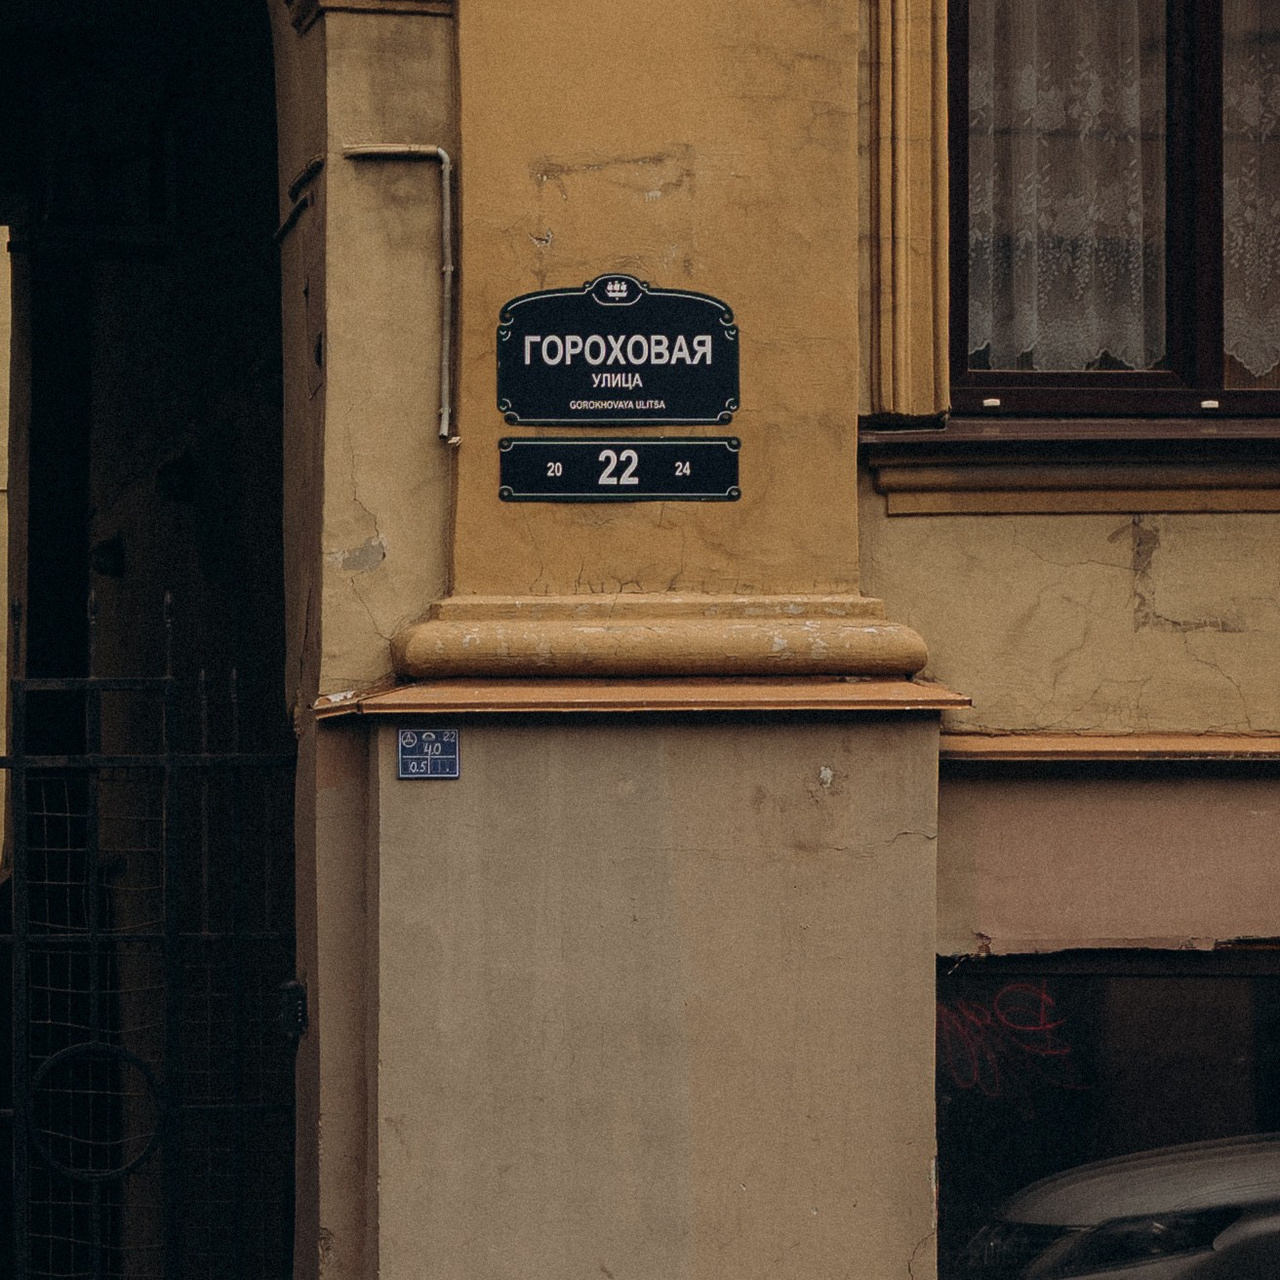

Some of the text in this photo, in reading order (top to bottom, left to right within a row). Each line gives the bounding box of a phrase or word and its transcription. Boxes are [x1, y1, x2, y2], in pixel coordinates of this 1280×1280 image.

[524, 334, 712, 366] ГОРОХОВАЯ
[592, 373, 643, 390] УЛИЦА
[569, 400, 666, 410] GOROKHOVAYA ULITSA
[546, 449, 691, 485] 20 22 24
